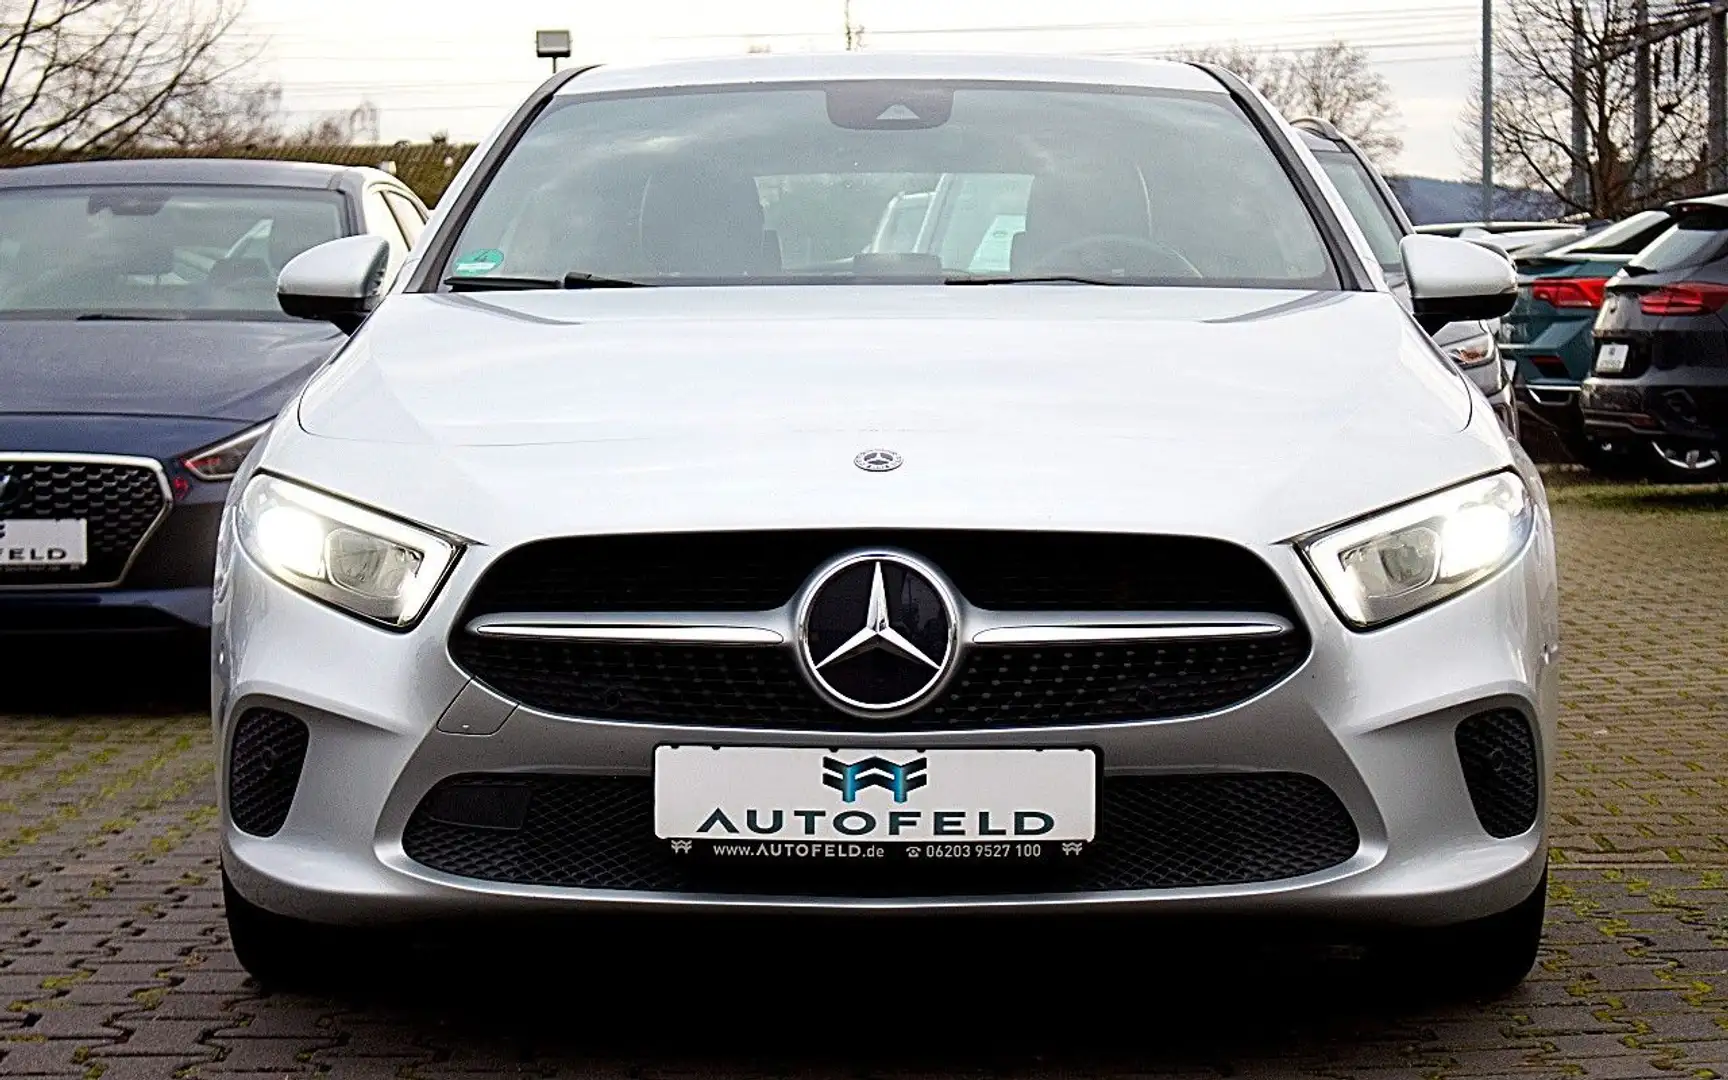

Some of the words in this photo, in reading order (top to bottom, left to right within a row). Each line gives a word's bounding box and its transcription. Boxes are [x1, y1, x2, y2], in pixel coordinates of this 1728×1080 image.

[0, 548, 67, 560] ELD
[696, 807, 1055, 836] AUTOFELD
[713, 843, 885, 858] www.AUTOFELD.de
[926, 845, 971, 858] 06203
[975, 844, 1011, 858] 9527
[1016, 844, 1041, 857] 100
